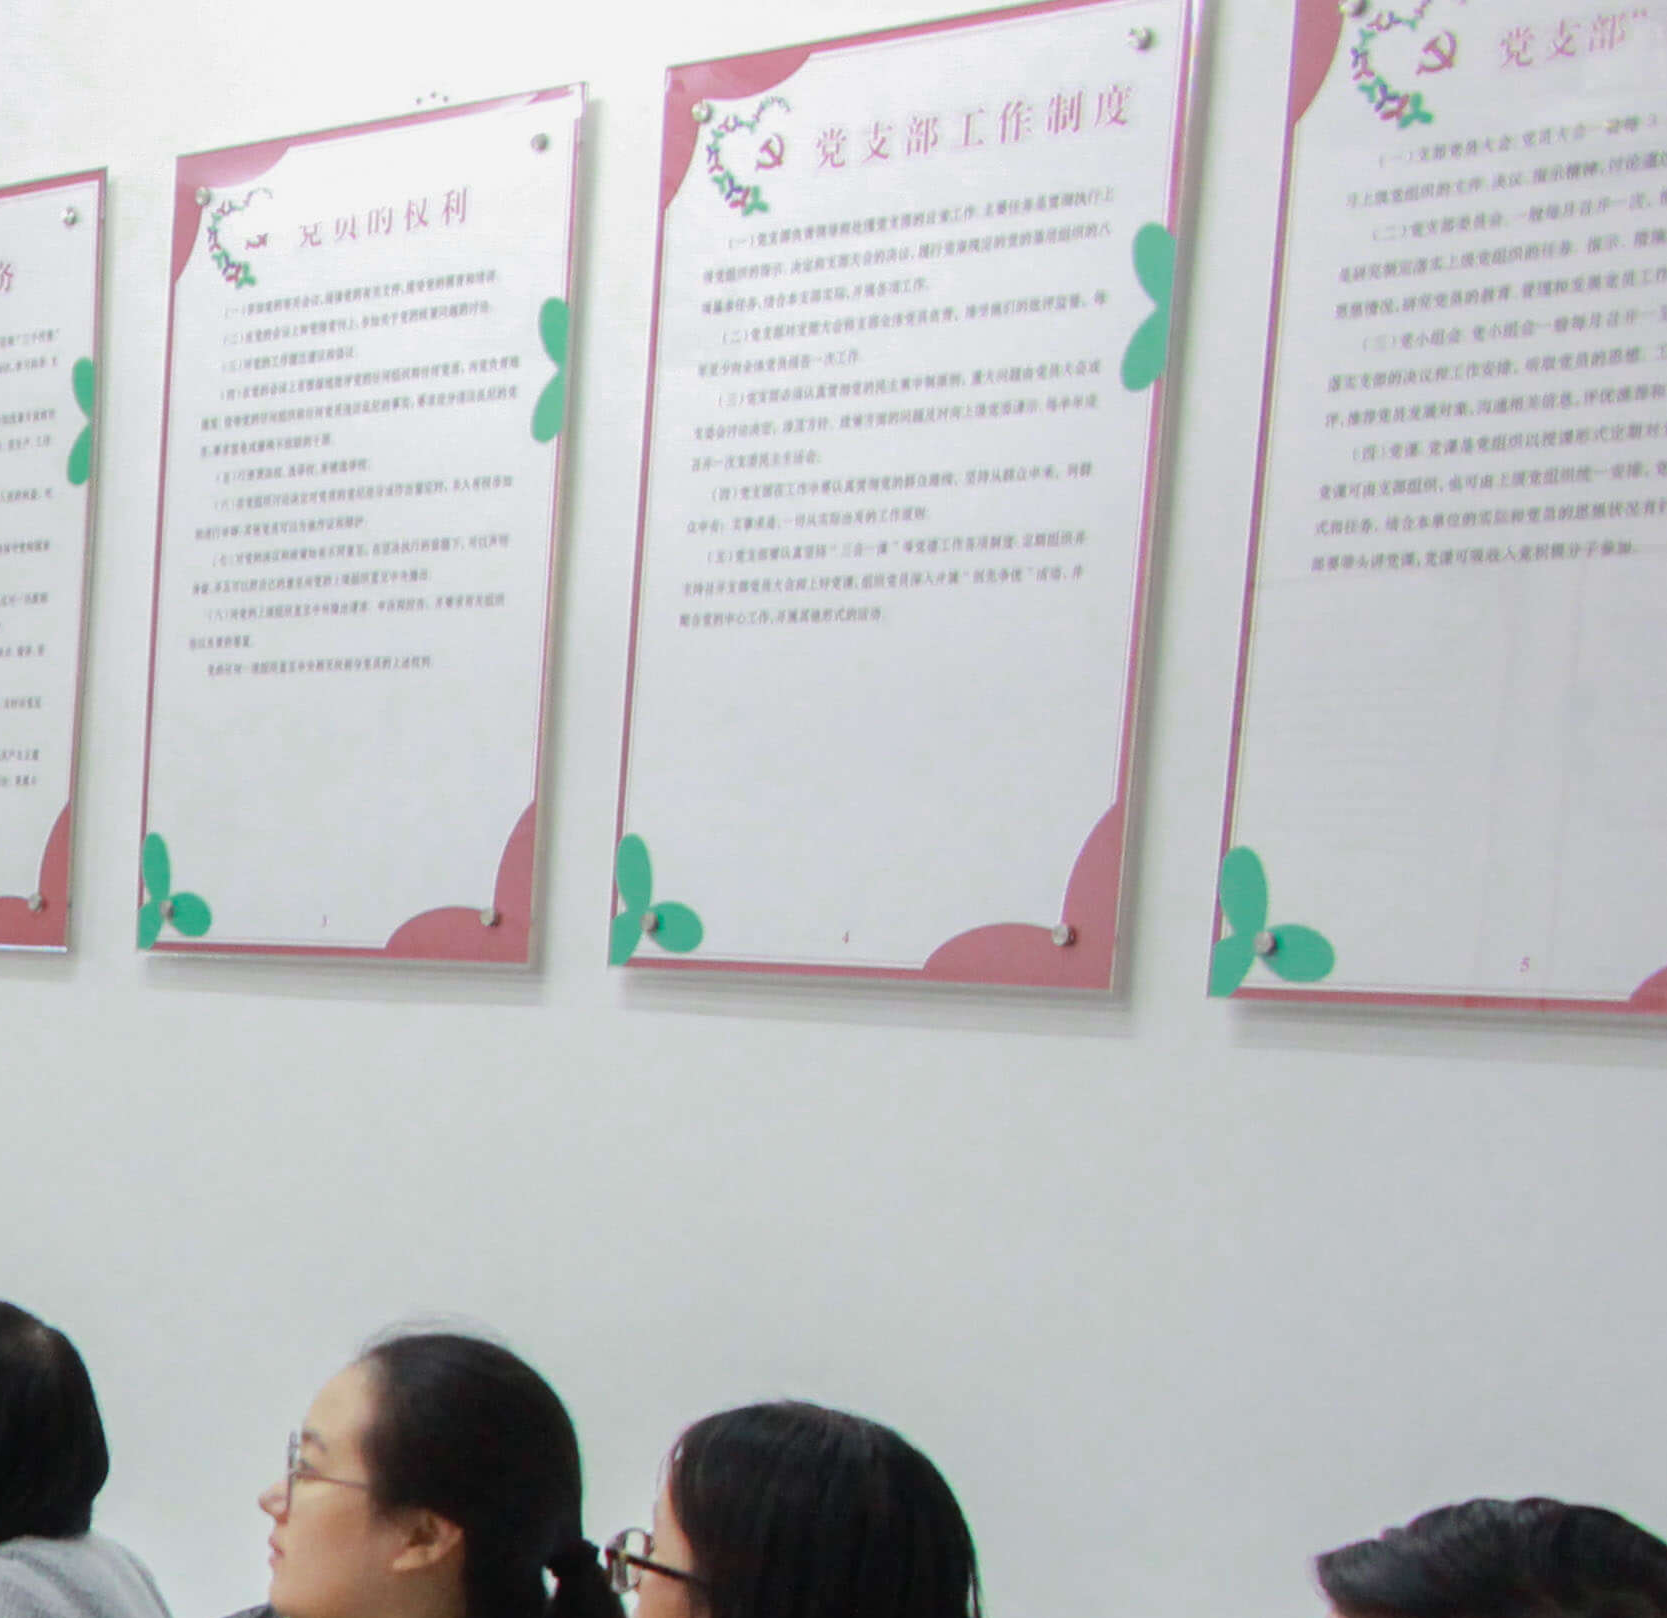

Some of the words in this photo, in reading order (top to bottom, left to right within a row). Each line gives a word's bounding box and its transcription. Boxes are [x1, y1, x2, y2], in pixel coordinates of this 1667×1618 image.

[815, 85, 1132, 169] 党支部工作制度
